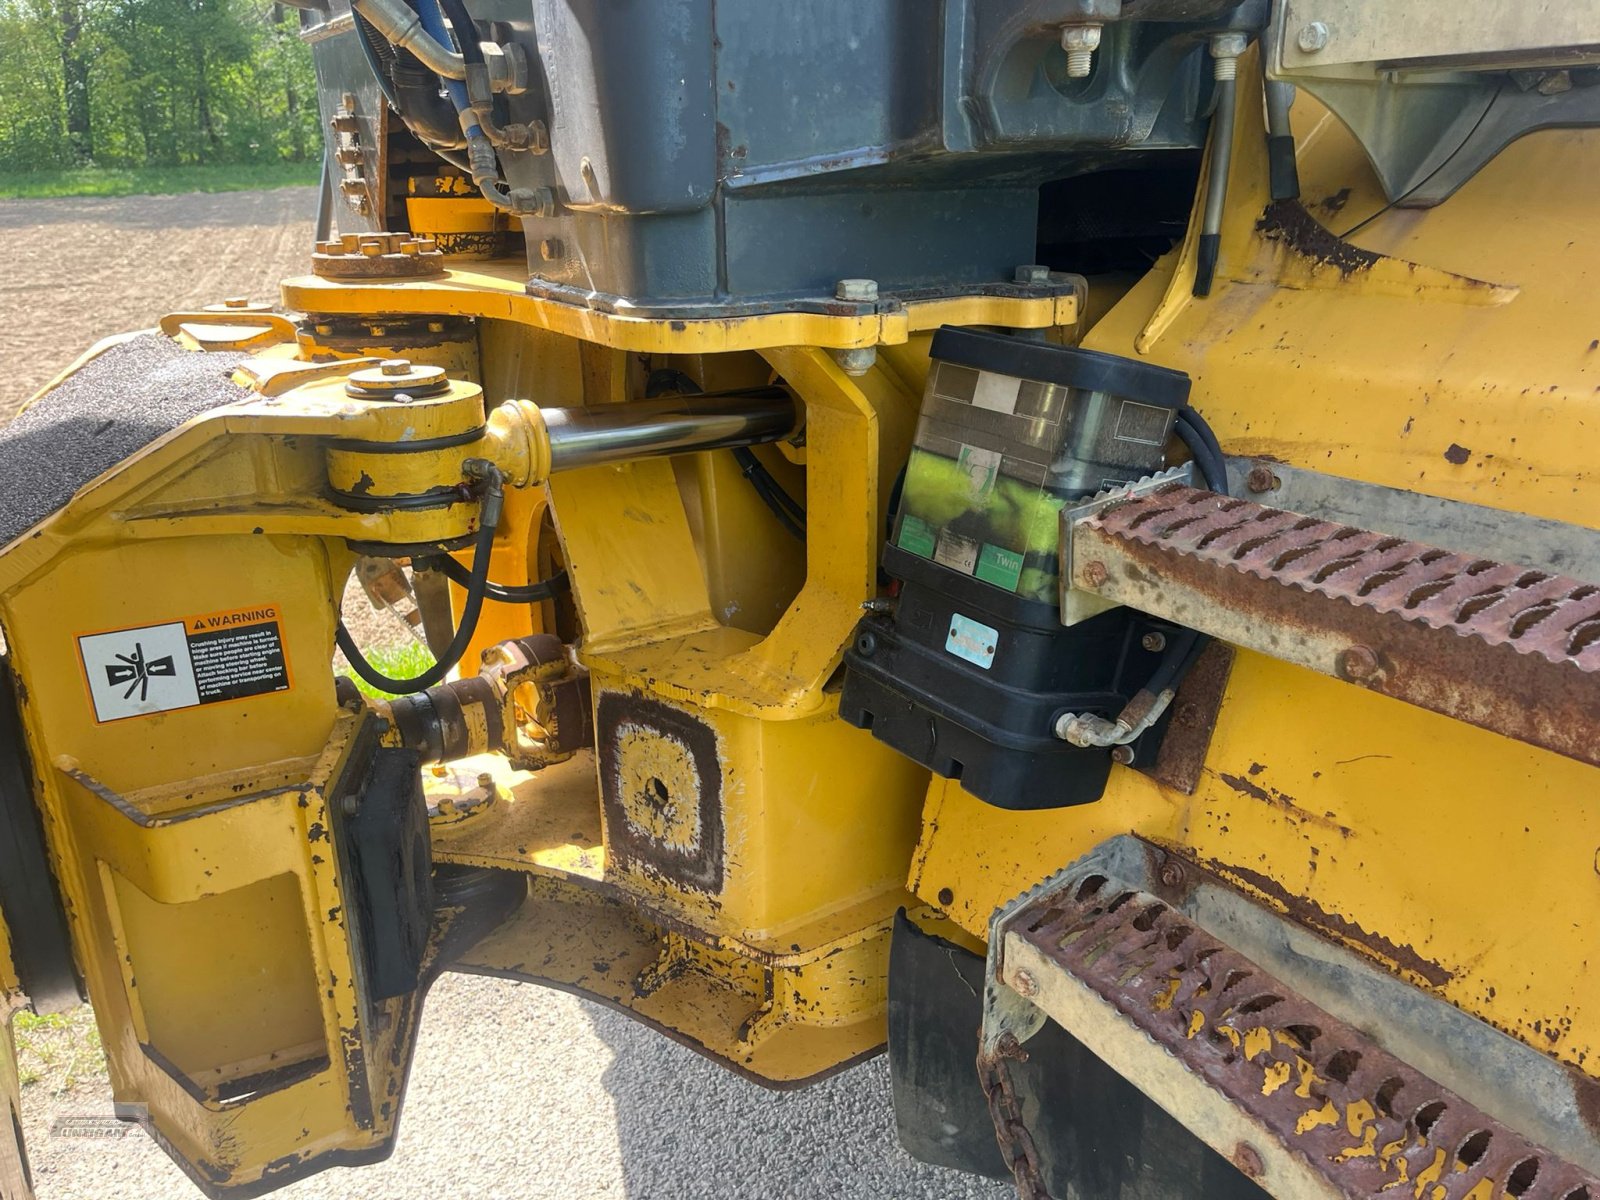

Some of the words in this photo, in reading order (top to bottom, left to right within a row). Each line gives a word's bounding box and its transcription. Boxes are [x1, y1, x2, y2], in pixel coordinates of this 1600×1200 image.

[996, 553, 1018, 570] Twin
[208, 609, 275, 626] WARNING
[191, 640, 217, 648] Crushing
[224, 648, 243, 656] people
[195, 658, 218, 666] machine
[226, 659, 249, 667] steering
[217, 667, 238, 675] locking
[198, 675, 229, 684] performing
[239, 673, 273, 683] transporting
